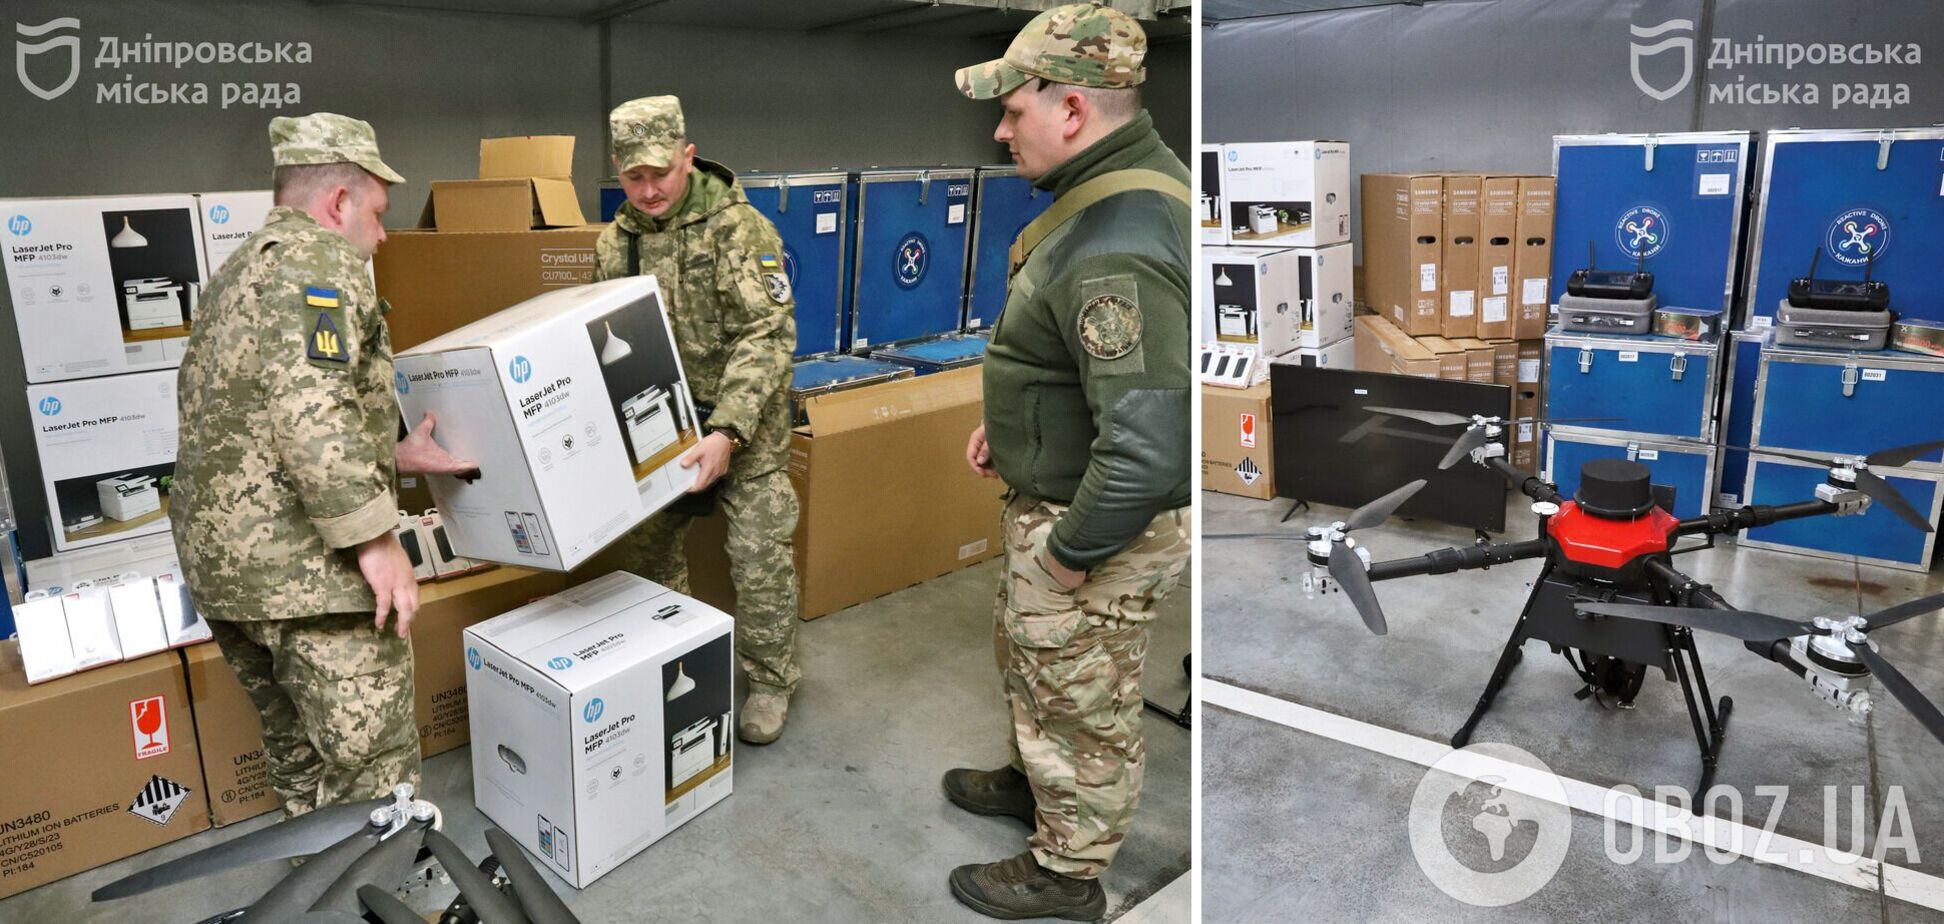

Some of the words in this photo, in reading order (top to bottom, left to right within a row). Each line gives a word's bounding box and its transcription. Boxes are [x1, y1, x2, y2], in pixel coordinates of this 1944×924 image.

[209, 205, 229, 224] hp
[1836, 210, 1867, 225] REACTIVE
[8, 215, 32, 236] hp
[212, 232, 246, 240] LaserJet
[12, 243, 54, 254] LaserJet
[56, 243, 73, 251] Pro
[14, 254, 36, 263] MFP
[541, 253, 577, 265] Crystal
[408, 372, 433, 382] LaserJet
[433, 370, 445, 380] Pro
[445, 368, 459, 378] MFP
[509, 355, 532, 384] hp
[519, 383, 555, 408] LaserJet
[556, 376, 571, 389] Pro
[39, 396, 61, 416] hp
[523, 402, 542, 419] MFP
[544, 390, 570, 408] 4103dw
[43, 421, 80, 432] LaserJet
[82, 419, 98, 427] Pro
[99, 416, 118, 425] MFP
[608, 632, 624, 641] Pro
[467, 646, 482, 671] hp
[548, 657, 573, 671] hp
[580, 650, 599, 661] MFP
[484, 658, 509, 680] LaserJet
[509, 675, 520, 686] Pro
[520, 681, 534, 694] MFP
[583, 697, 604, 723] hp
[584, 722, 620, 745] LaserJet
[621, 713, 636, 726] Pro
[585, 739, 603, 754] MFP
[605, 727, 631, 743] 4103dw
[138, 747, 167, 757] FRAGILE
[42, 821, 62, 833] ION
[63, 803, 120, 827] BATTERIES
[161, 814, 166, 822] 9
[1, 842, 63, 867] CN/C520105
[3, 861, 35, 877] PI:184
